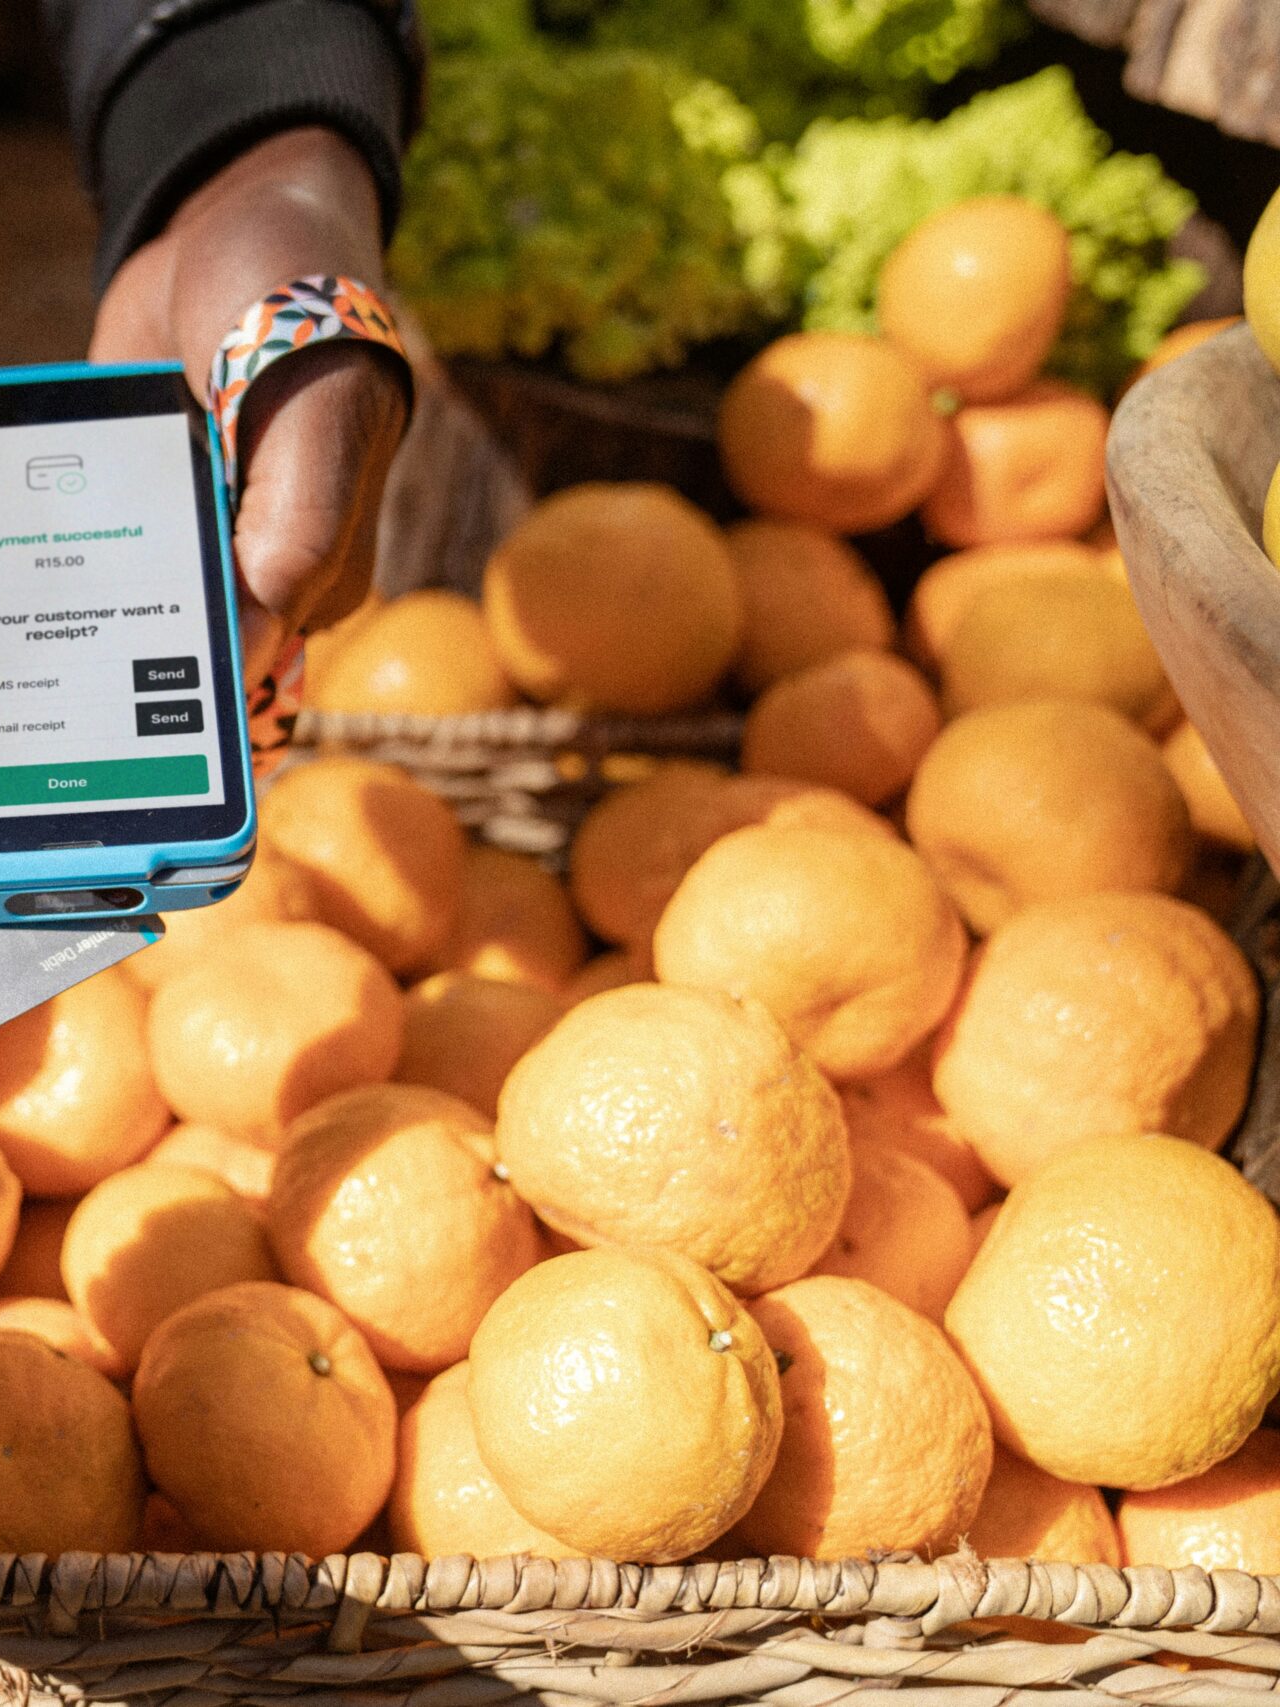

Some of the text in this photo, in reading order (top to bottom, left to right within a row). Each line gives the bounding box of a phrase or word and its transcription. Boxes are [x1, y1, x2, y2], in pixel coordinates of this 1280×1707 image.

[52, 525, 143, 544] successful
[35, 555, 84, 570] R15.00
[34, 605, 117, 624] customer
[121, 604, 164, 617] want
[169, 604, 181, 615] a
[25, 625, 98, 642] receipt?
[147, 668, 186, 681] Send
[17, 677, 60, 693] receipt
[151, 711, 189, 725] Send
[22, 719, 66, 735] receipt
[48, 776, 88, 790] Done
[40, 947, 77, 971] Debit
